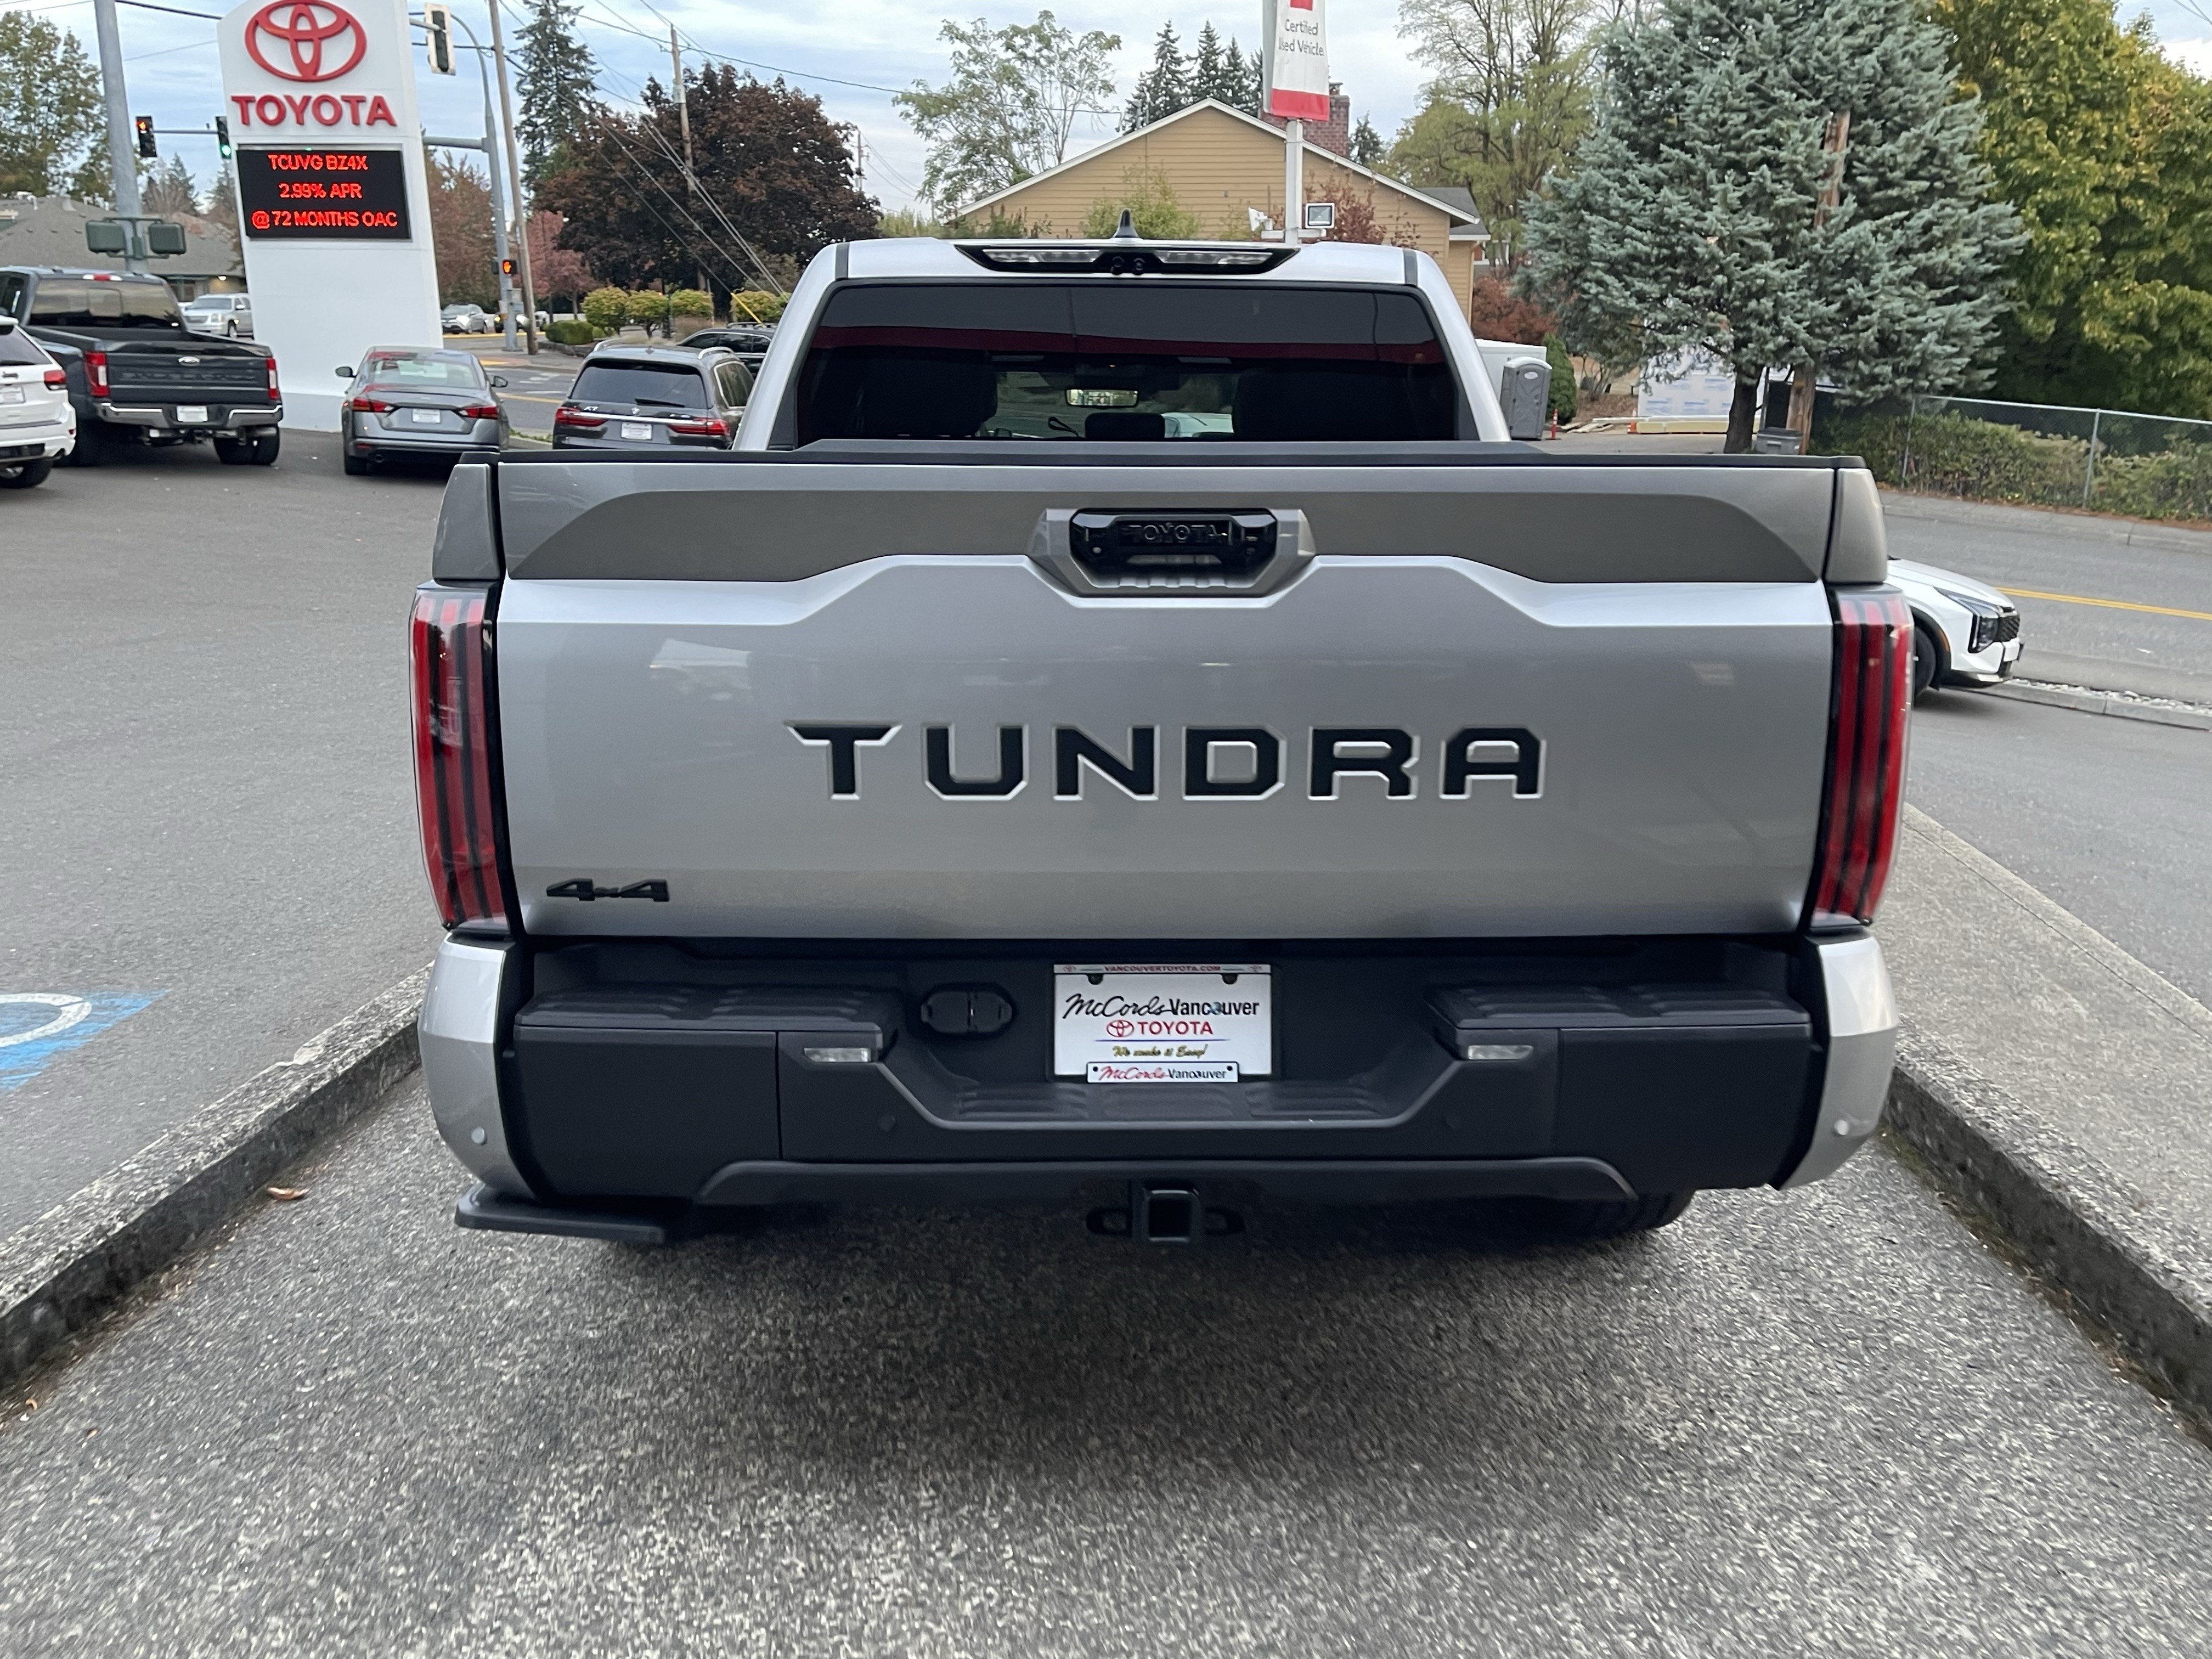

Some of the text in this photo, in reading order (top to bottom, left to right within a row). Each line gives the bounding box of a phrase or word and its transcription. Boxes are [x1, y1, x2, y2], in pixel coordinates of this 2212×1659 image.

[1285, 19, 1318, 36] Certified
[1297, 40, 1325, 57] Vehicle
[231, 94, 397, 126] TOYOTA
[268, 154, 368, 171] TCUVG BZ4X
[279, 183, 363, 199] 2.99% APR
[252, 211, 398, 229] @ 72 MONTHS OAC
[785, 724, 1547, 801] TUNDRA
[1169, 998, 1260, 1015] Vancouver
[1137, 1021, 1214, 1035] TOYOTA
[1167, 1069, 1227, 1079] Vancouver
